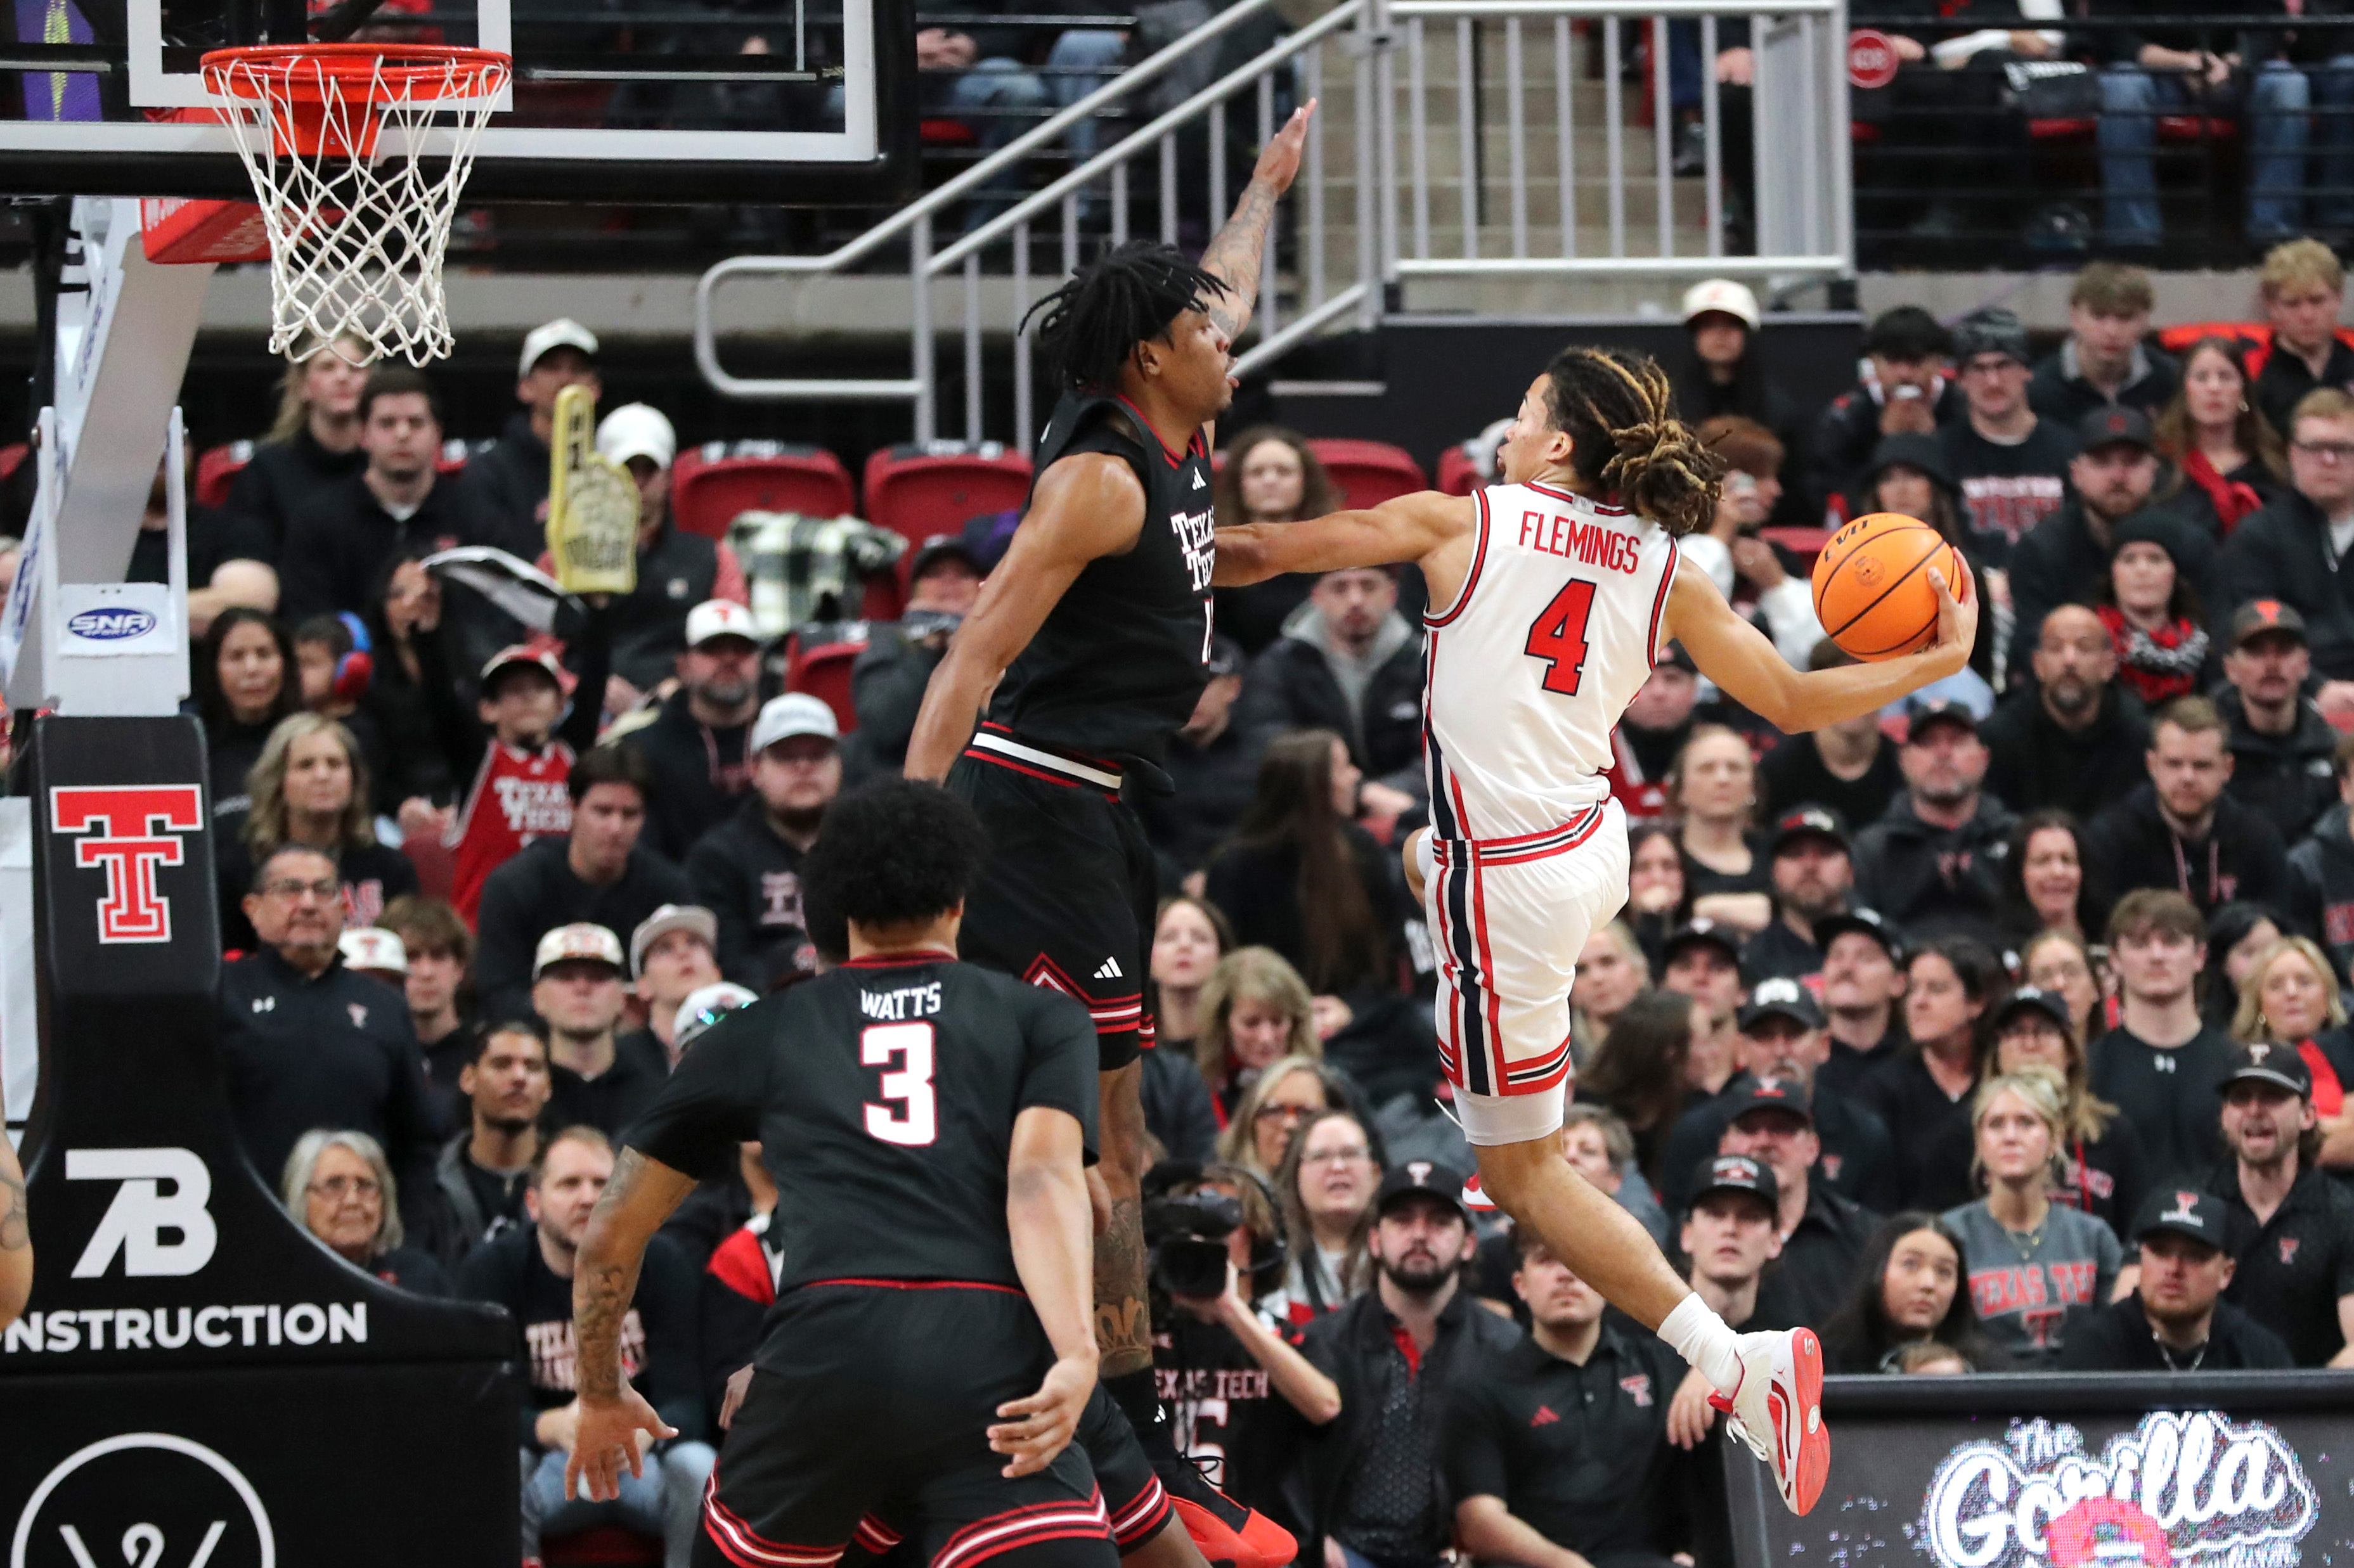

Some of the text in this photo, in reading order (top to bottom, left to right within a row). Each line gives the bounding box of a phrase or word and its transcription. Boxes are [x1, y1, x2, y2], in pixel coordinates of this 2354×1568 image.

[1518, 510, 1641, 574] FLEMINGS
[71, 615, 150, 631] SNA
[1523, 577, 1597, 697] 4
[860, 981, 942, 1020] WATTS
[859, 1019, 939, 1148] 3
[65, 1147, 217, 1278] 7B
[0, 1302, 368, 1354] NSTRUCTION
